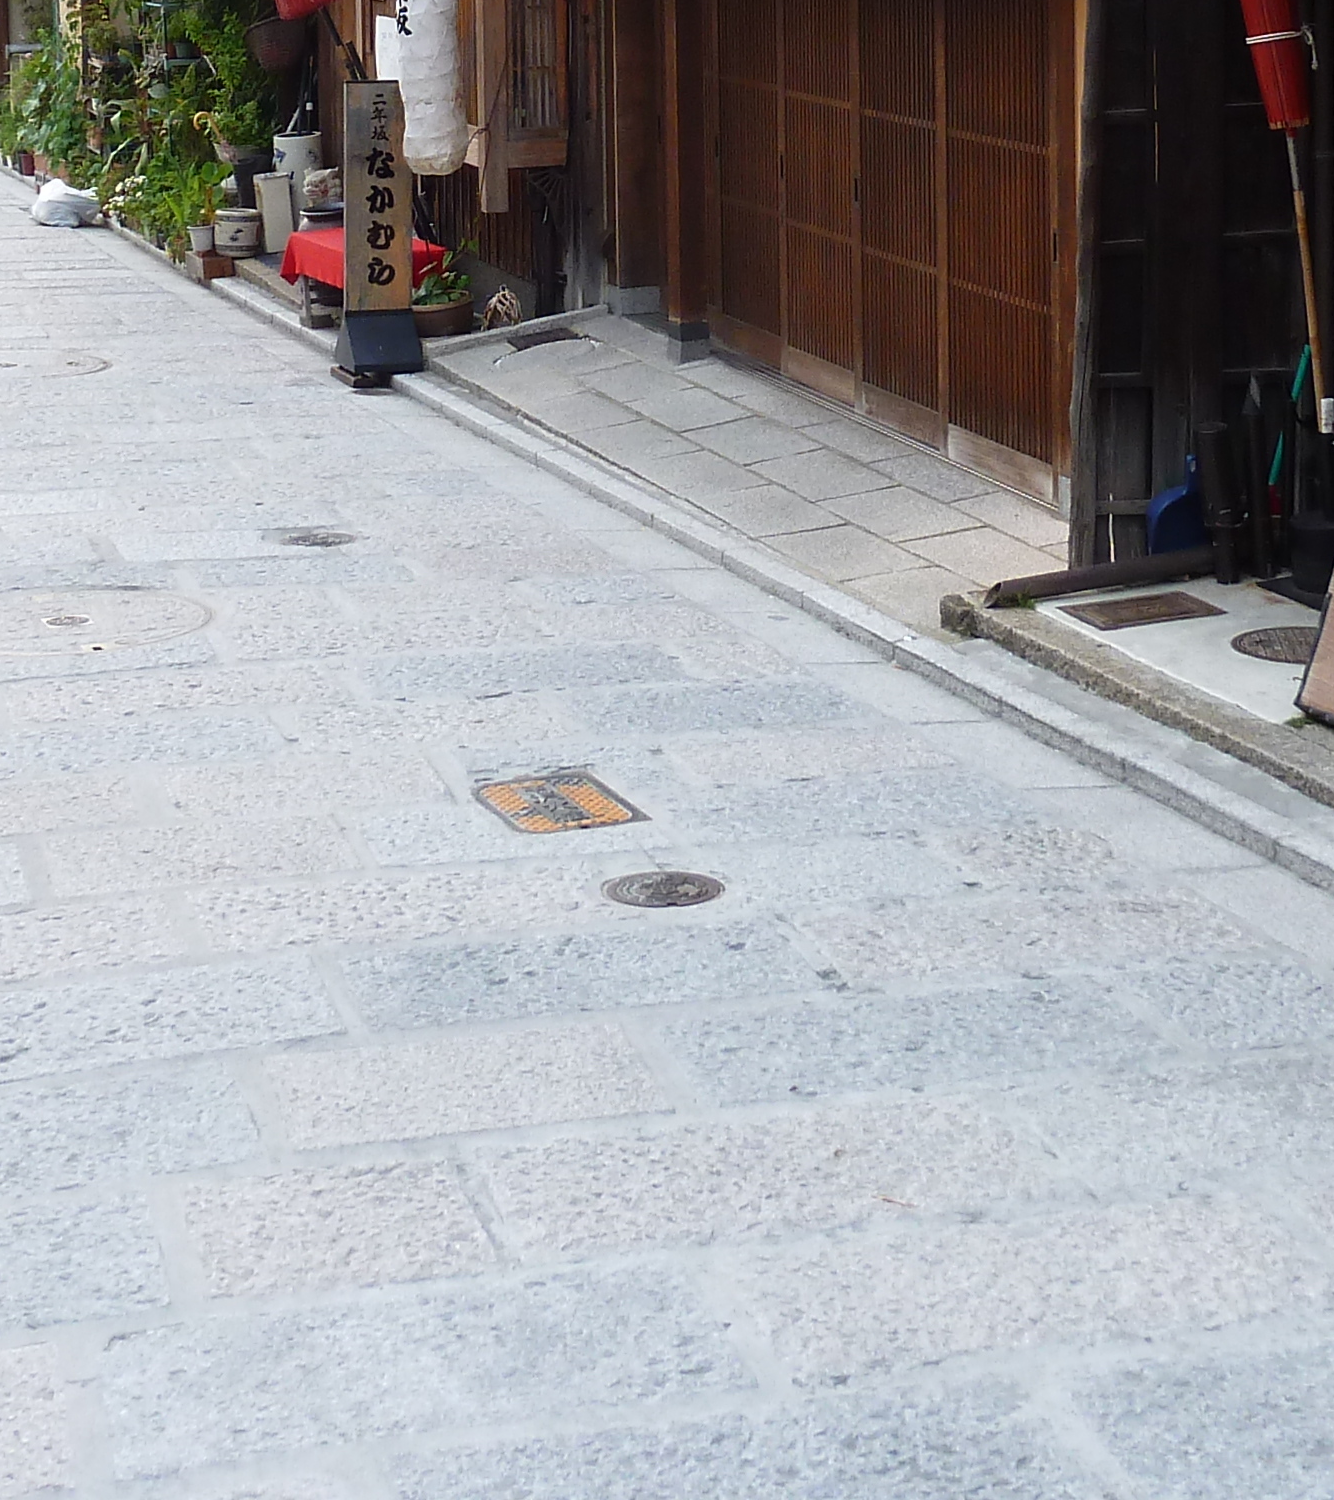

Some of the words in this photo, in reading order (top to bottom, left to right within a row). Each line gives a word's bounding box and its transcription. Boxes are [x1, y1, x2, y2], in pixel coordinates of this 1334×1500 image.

[370, 92, 390, 142] 二年坂
[364, 146, 396, 288] なかむら
